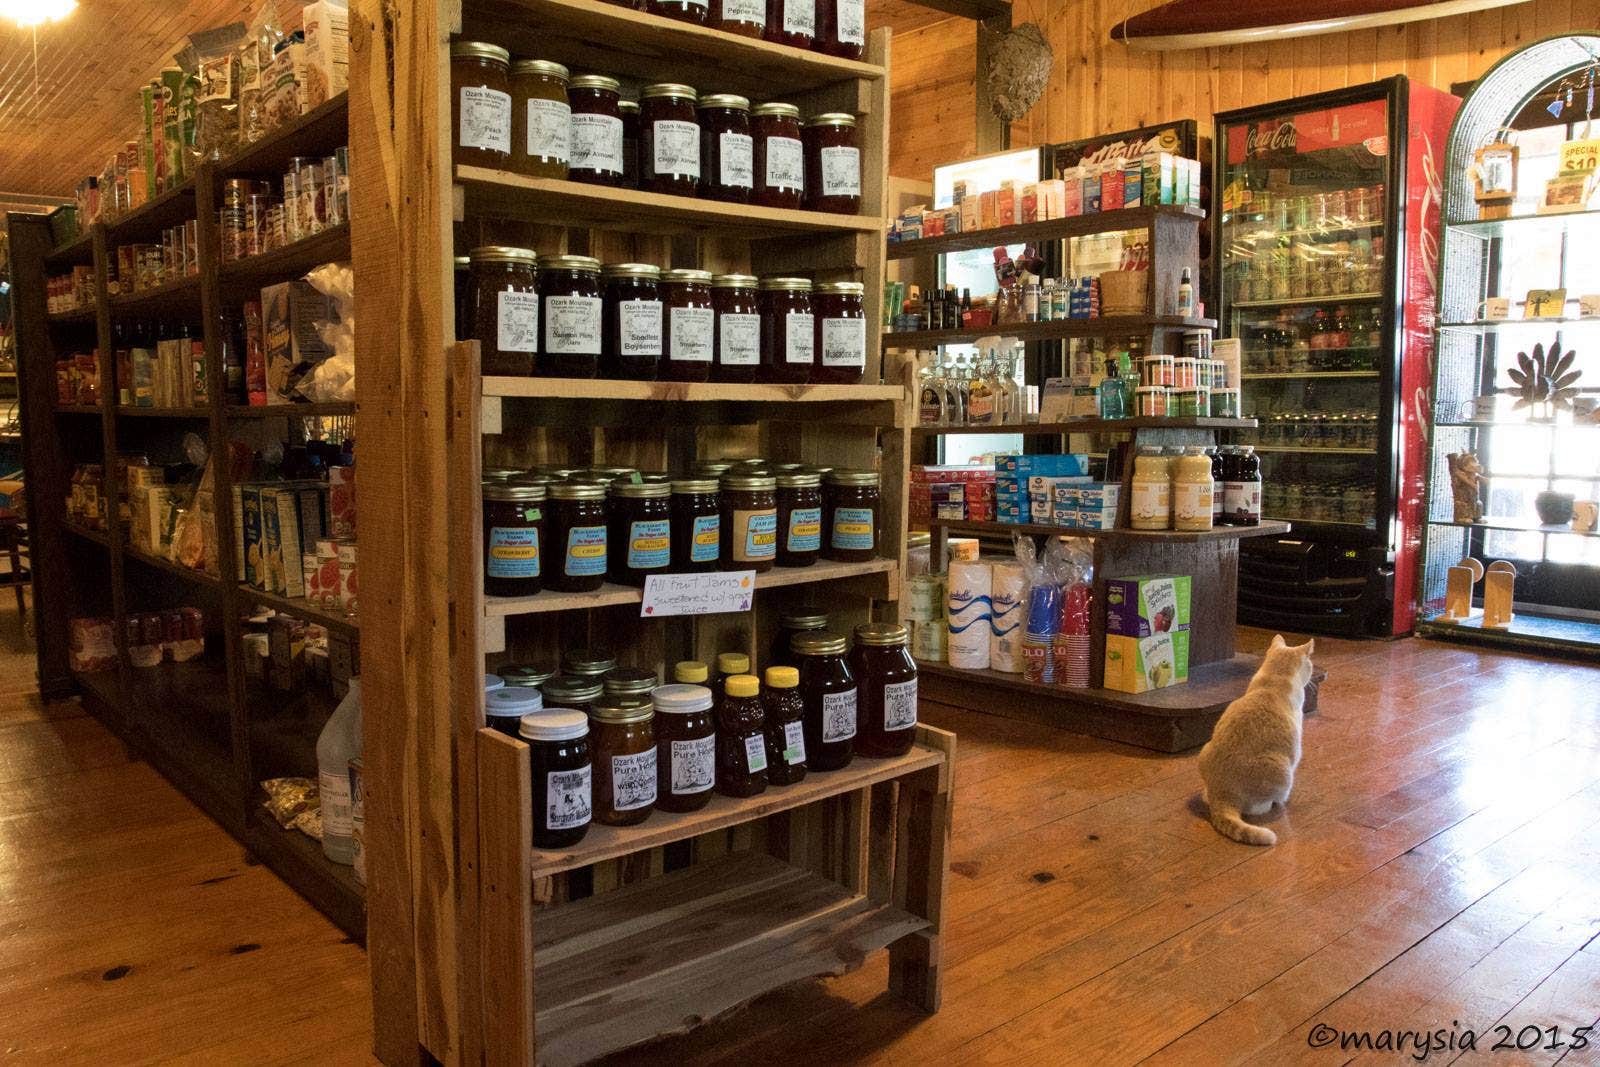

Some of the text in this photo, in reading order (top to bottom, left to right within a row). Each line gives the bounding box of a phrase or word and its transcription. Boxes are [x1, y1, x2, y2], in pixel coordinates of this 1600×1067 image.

[465, 90, 483, 99] Ozark
[571, 116, 588, 124] Ozark
[484, 126, 502, 135] Peach
[658, 123, 675, 131] Ozark
[1566, 145, 1599, 158] SPECIAL
[770, 171, 793, 180] Traffic
[826, 180, 849, 189] Traffic
[504, 295, 521, 303] Ozark
[631, 333, 659, 341] Seedless
[650, 574, 740, 593] All Fruit Jams
[885, 685, 902, 694] Ozark
[824, 695, 842, 705] Ozark
[886, 693, 904, 701] Pure
[825, 704, 843, 712] Pure
[673, 742, 693, 752] Ozark
[673, 751, 696, 760] Pure
[613, 758, 634, 767] Ozark
[614, 766, 637, 776] Pure
[552, 774, 571, 784] Ozark
